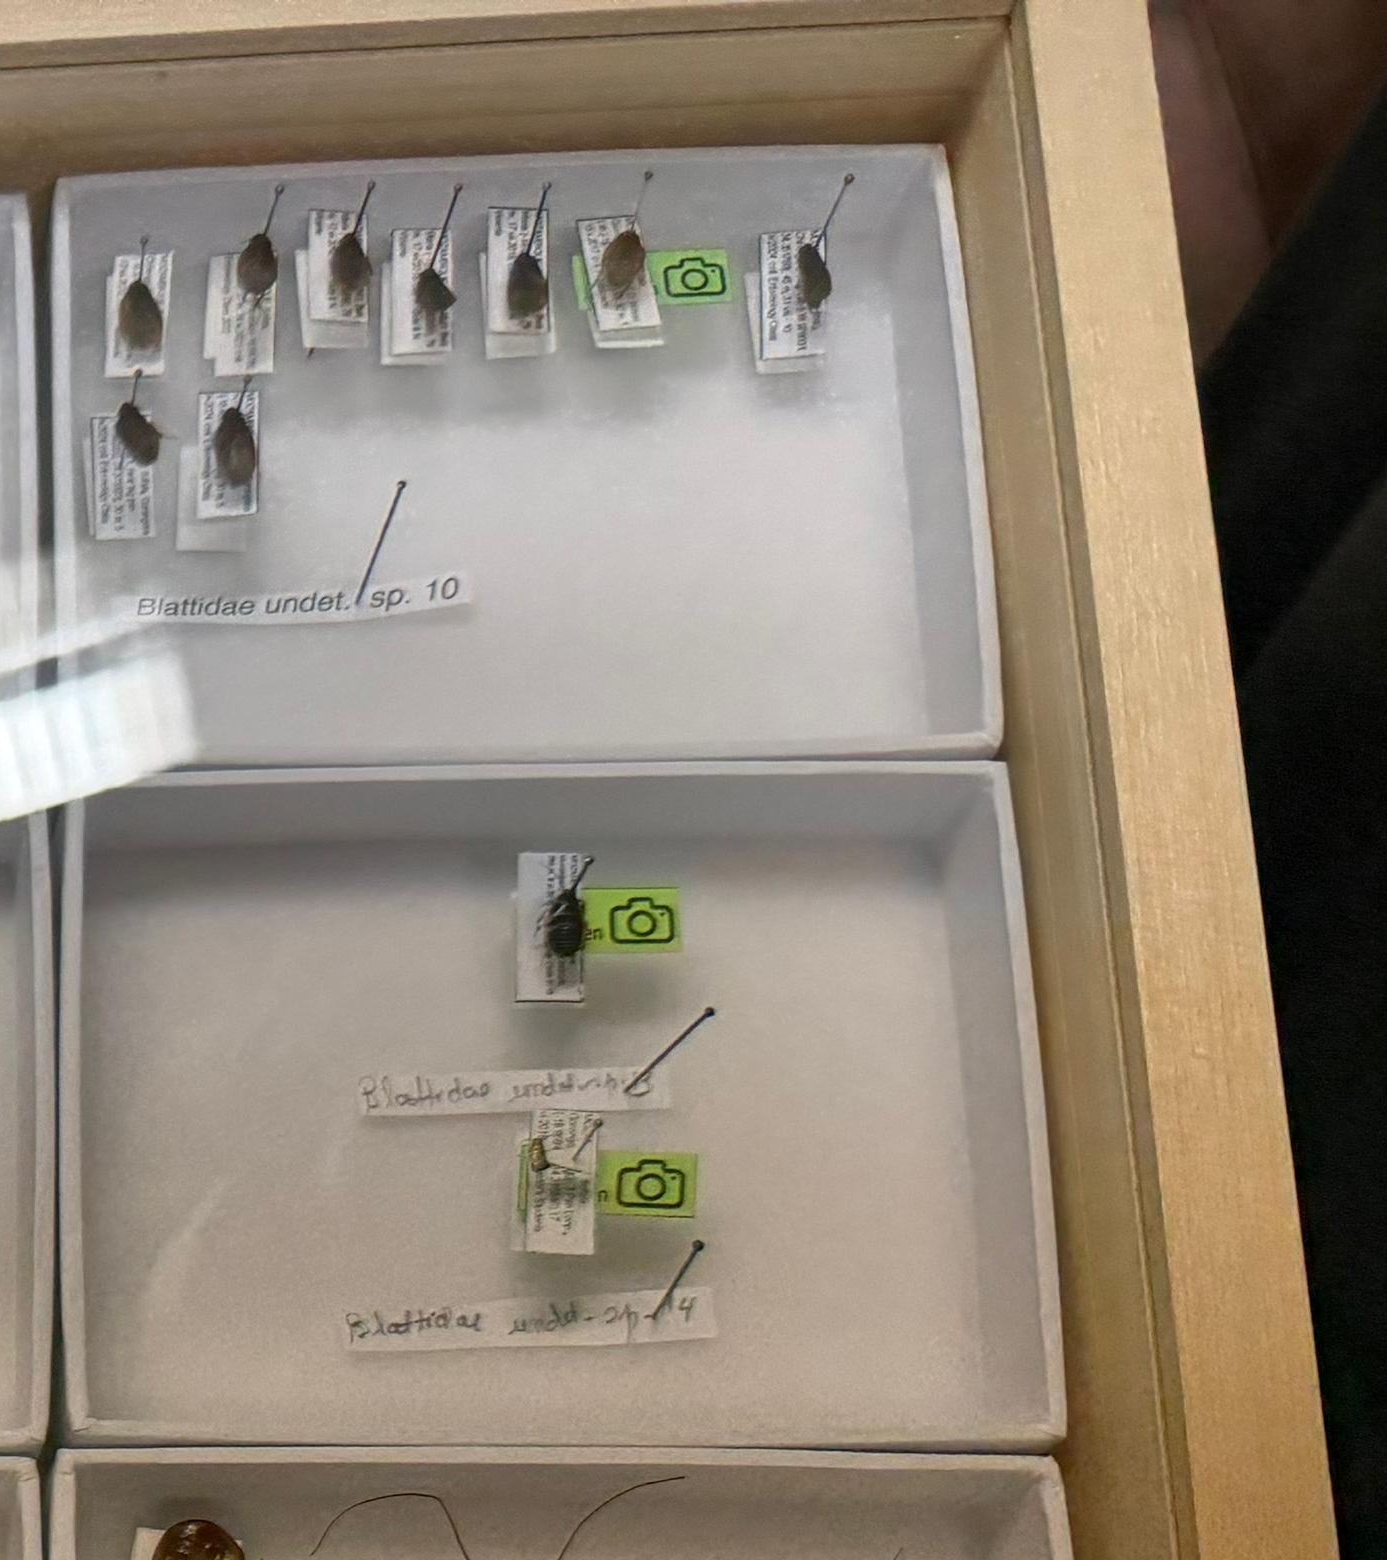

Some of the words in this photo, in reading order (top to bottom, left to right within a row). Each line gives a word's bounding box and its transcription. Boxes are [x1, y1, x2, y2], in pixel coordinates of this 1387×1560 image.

[137, 597, 255, 617] Blattidae
[265, 595, 350, 615] undet.
[370, 587, 410, 612] sp.
[427, 576, 460, 602] 10
